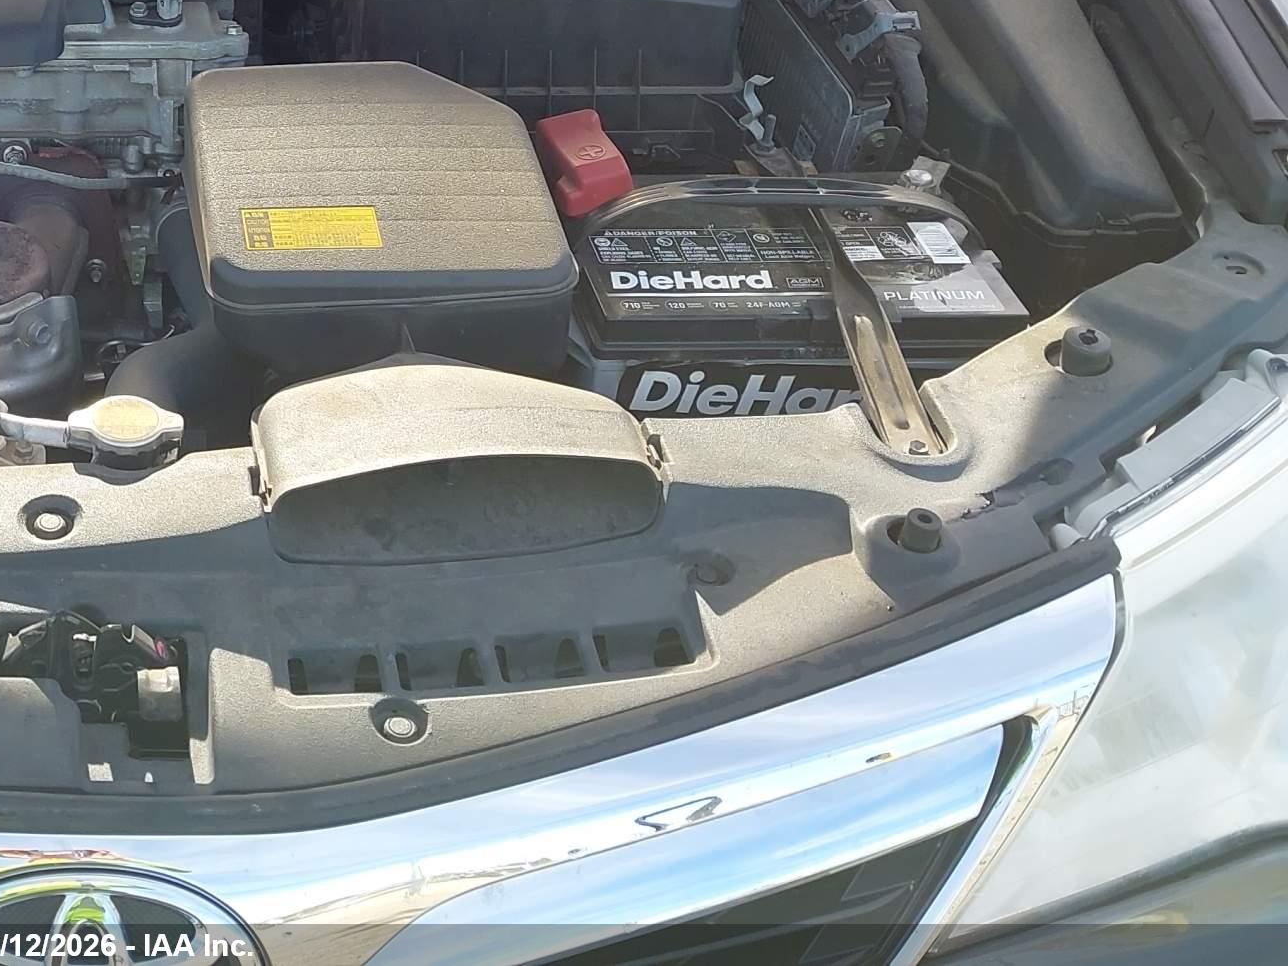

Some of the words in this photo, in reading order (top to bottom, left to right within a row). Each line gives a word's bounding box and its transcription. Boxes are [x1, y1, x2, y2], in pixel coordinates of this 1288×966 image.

[611, 270, 773, 290] DieHard
[883, 290, 986, 301] PLATINUM
[623, 301, 641, 309] 710
[667, 301, 686, 309] 120
[629, 370, 863, 415] DieHar
